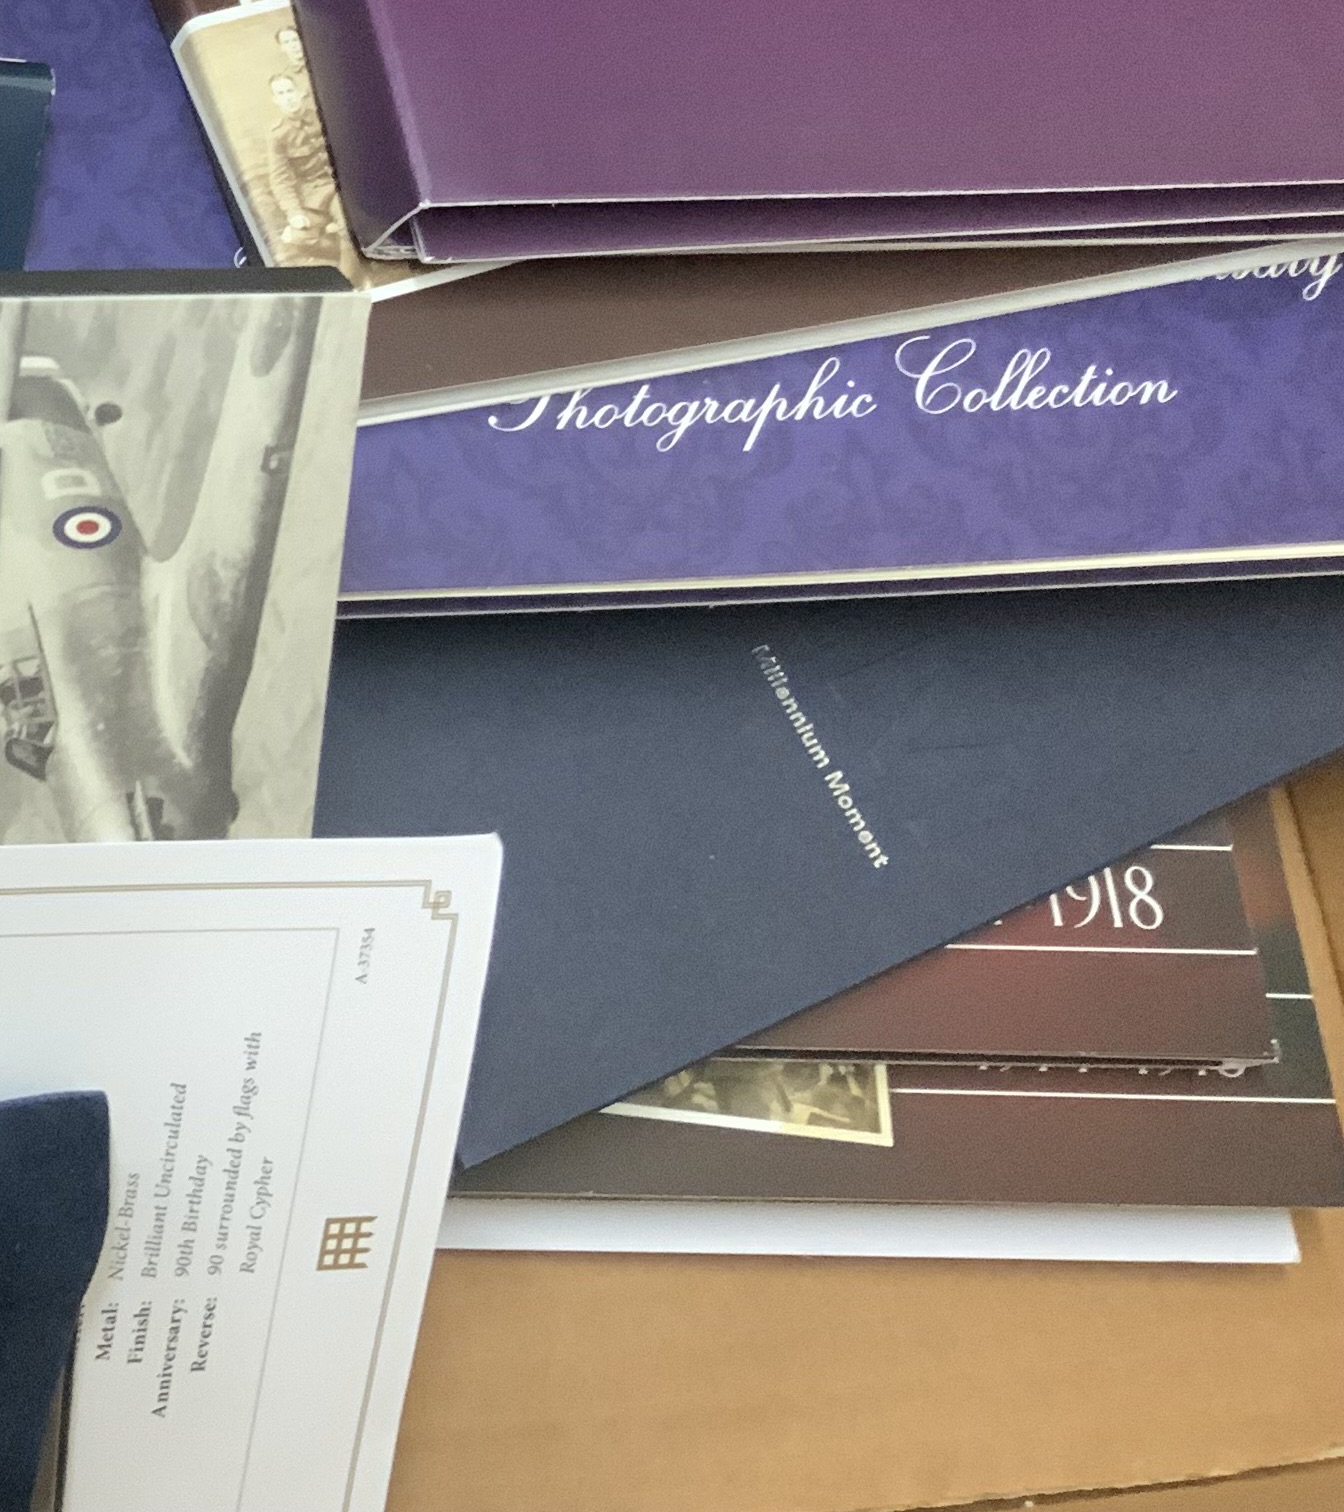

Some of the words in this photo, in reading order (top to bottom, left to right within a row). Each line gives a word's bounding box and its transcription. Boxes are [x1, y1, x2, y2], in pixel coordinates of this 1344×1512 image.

[893, 334, 1180, 417] Collection
[751, 643, 831, 769] Millennium
[824, 770, 890, 869] Moment
[1048, 864, 1165, 930] 1918
[242, 1031, 263, 1070] with
[231, 1076, 259, 1118] flags
[228, 1122, 248, 1145] by
[126, 1300, 154, 1365] Finish:
[140, 1205, 169, 1280] Brilliant
[156, 1081, 188, 1199] Uncirculated
[179, 1154, 212, 1234] Birthday
[213, 1147, 242, 1251] surrounded
[246, 1155, 275, 1219] Cypher
[94, 1302, 120, 1361] Metal:
[108, 1170, 141, 1282] Nickel-Brass
[174, 1240, 192, 1278] 90th
[207, 1255, 223, 1277] 90
[239, 1224, 264, 1275] Royal
[151, 1298, 187, 1420] Anniversary:
[190, 1295, 219, 1374] Reverse:
